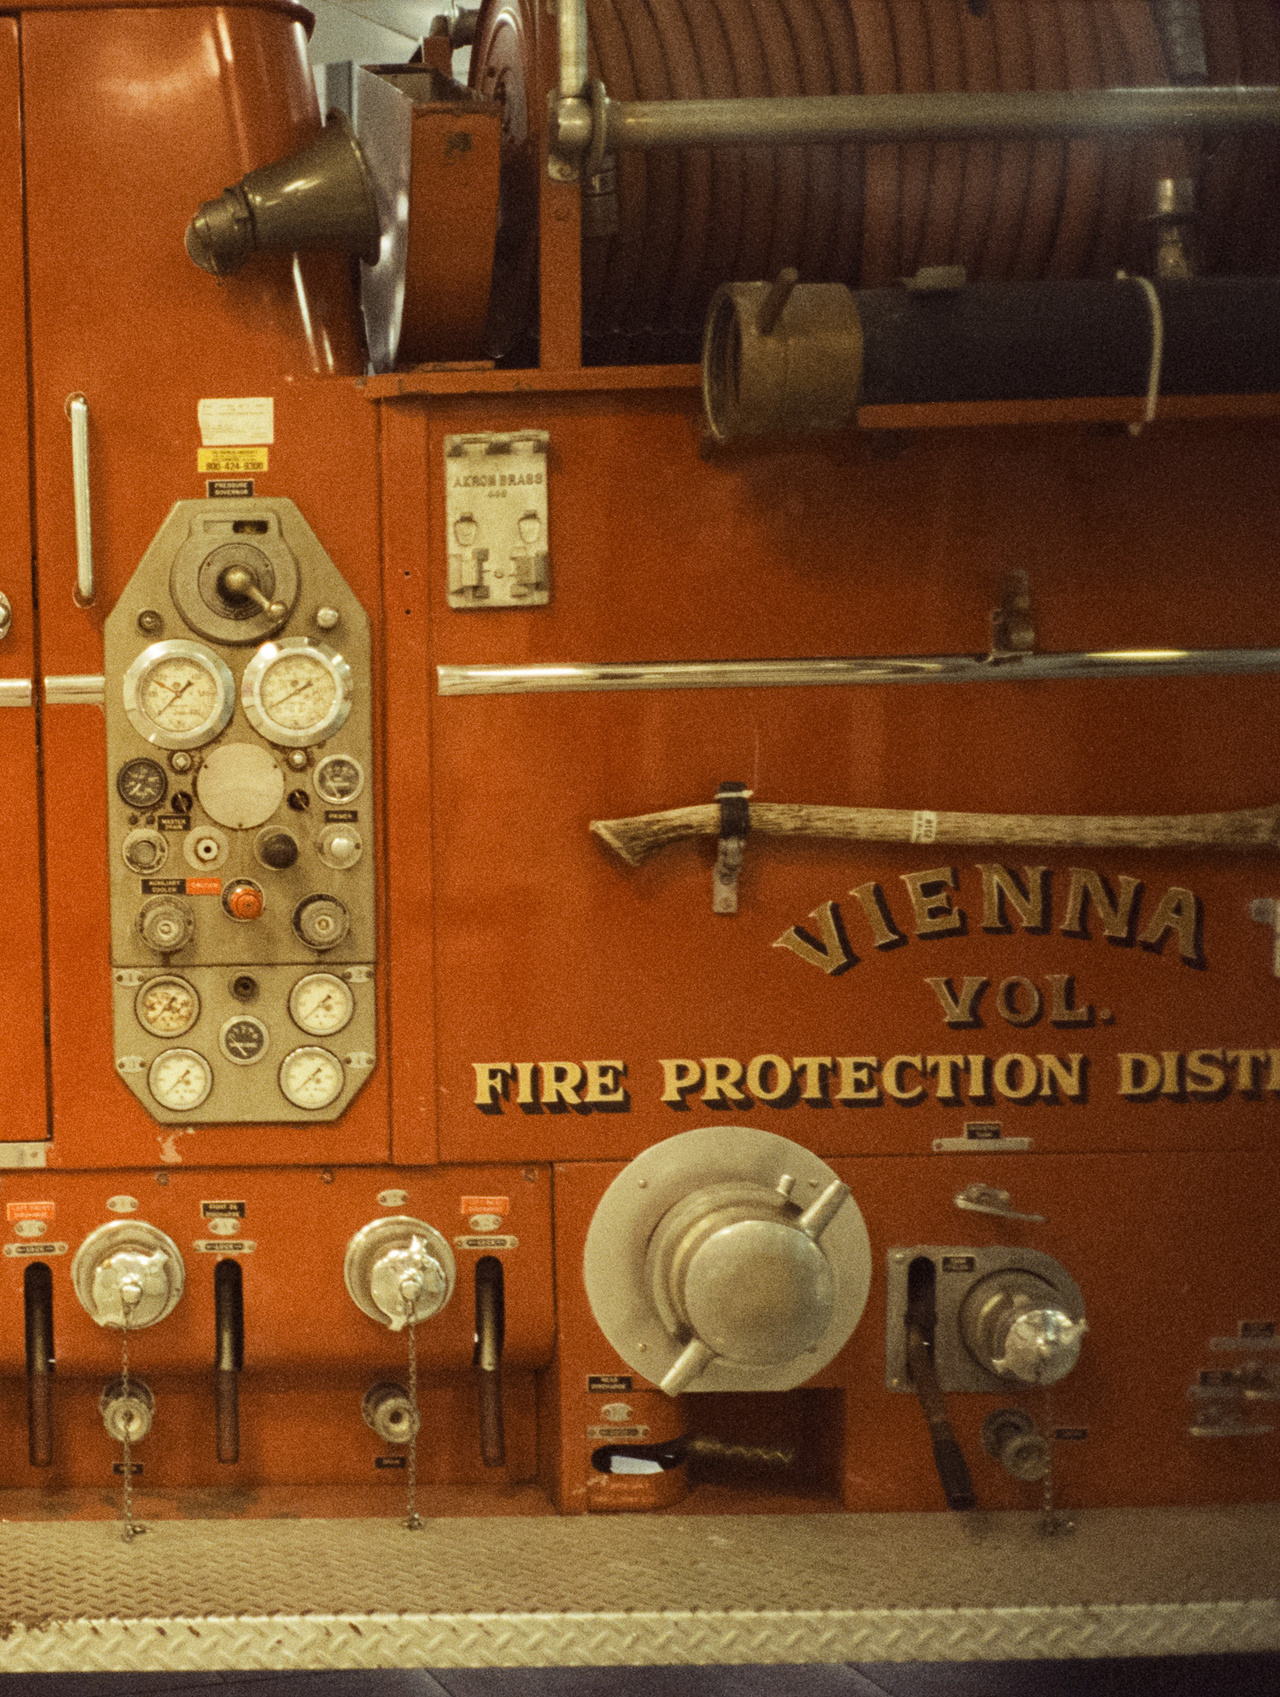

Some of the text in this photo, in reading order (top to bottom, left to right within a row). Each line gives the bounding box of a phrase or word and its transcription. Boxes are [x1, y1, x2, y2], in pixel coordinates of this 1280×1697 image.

[500, 472, 543, 486] BRASS
[772, 863, 1204, 975] VIENNA
[924, 974, 1114, 1026] VOL.
[472, 1059, 629, 1111] FIRE
[659, 1053, 1088, 1107] PROTECTION
